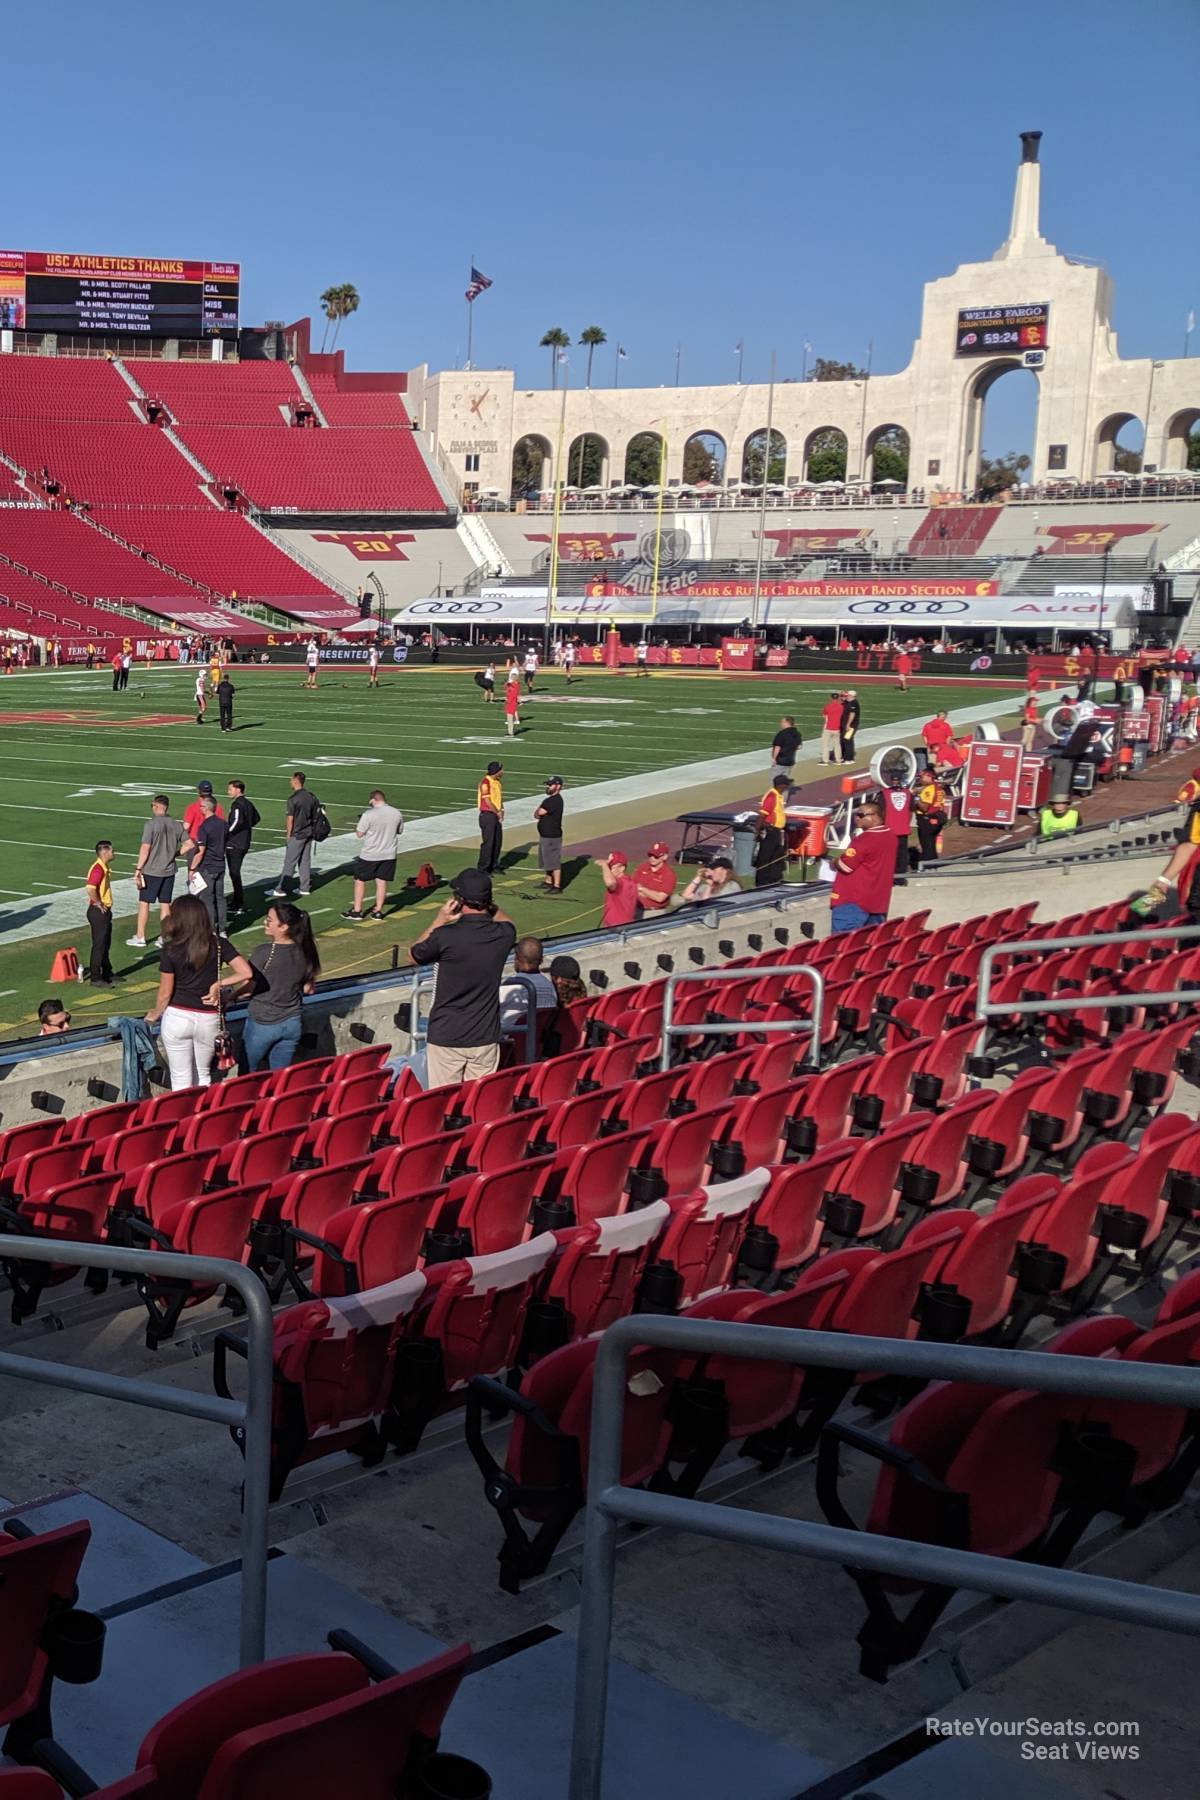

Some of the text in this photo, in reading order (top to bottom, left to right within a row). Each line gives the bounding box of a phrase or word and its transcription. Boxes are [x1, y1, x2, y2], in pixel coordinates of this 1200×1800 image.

[46, 255, 184, 273] USC ATHLETICS THANKS
[205, 284, 219, 292] CAL
[107, 302, 130, 310] TIMOTHY
[205, 301, 222, 309] MISS
[965, 307, 1042, 320] WELLS FARGO
[959, 319, 1004, 328] COUNTDOWN
[1016, 316, 1046, 324] KICKOFF
[1067, 532, 1115, 545] 33
[352, 540, 391, 552] 20
[623, 570, 699, 594] Allstate
[688, 587, 720, 596] BLAIR
[722, 587, 730, 596] &
[736, 586, 768, 596] RUTH
[787, 585, 822, 596] BLAIR
[825, 585, 870, 595] FAMILY
[872, 585, 907, 595] BAND
[912, 585, 966, 595] SECTION
[535, 603, 612, 613] Audi
[1011, 604, 1110, 613] Audi
[319, 650, 368, 660] RESENTED
[857, 653, 922, 670] UTS
